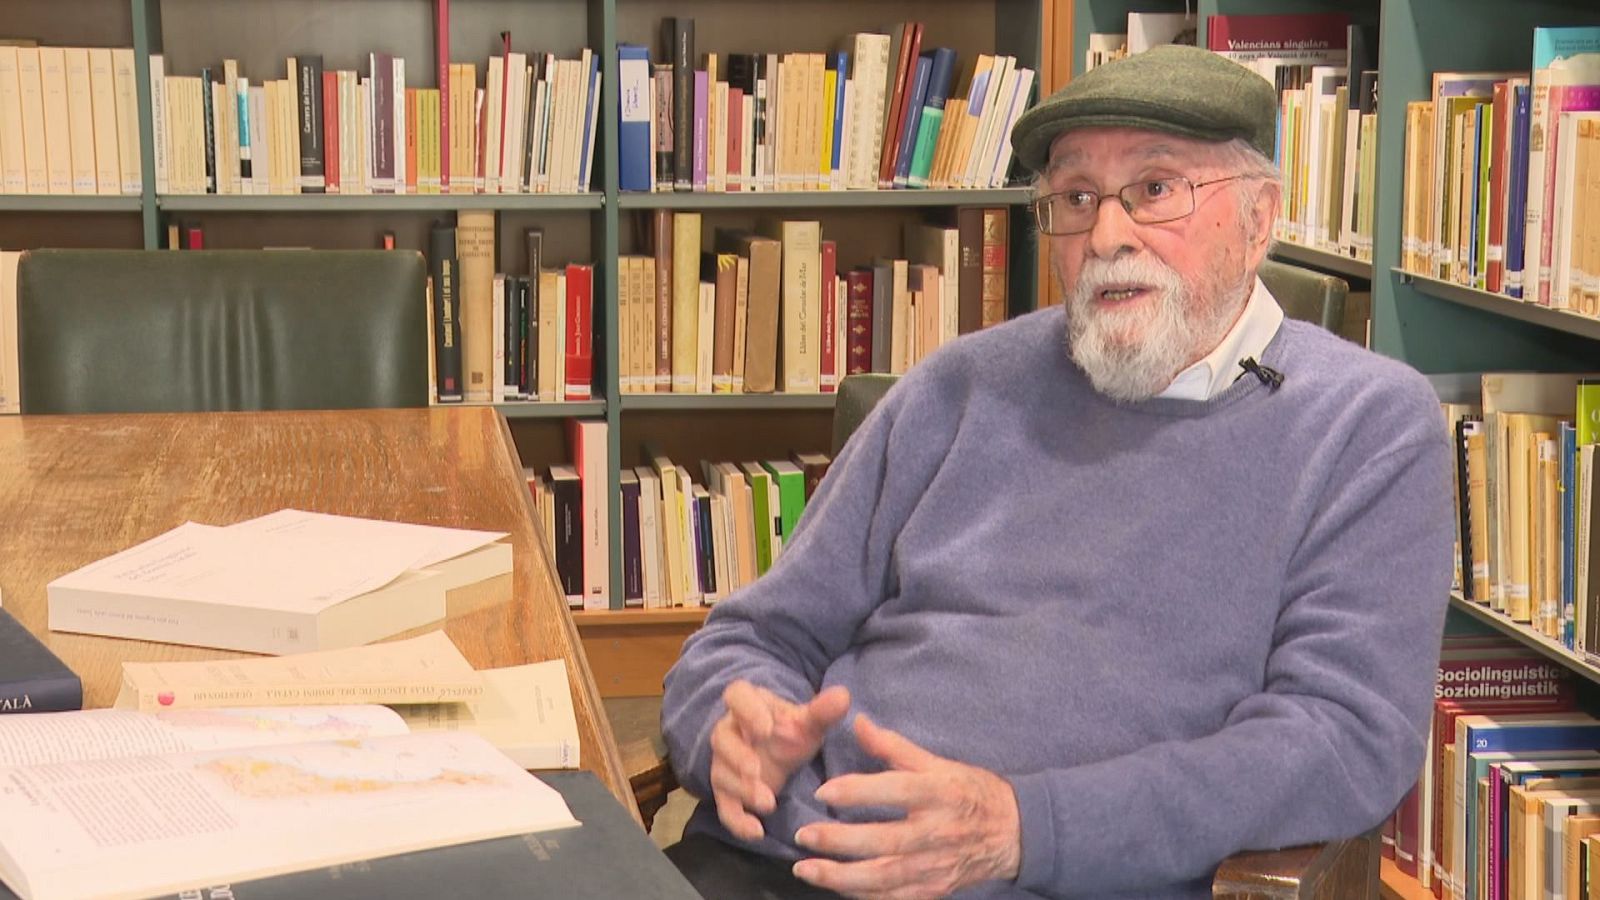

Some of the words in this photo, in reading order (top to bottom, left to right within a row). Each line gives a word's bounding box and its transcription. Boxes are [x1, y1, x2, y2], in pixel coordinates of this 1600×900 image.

[1228, 39, 1281, 50] Valencians
[1284, 38, 1328, 51] singulars
[1434, 682, 1559, 698] Soziolinguistik
[1476, 738, 1488, 748] 20
